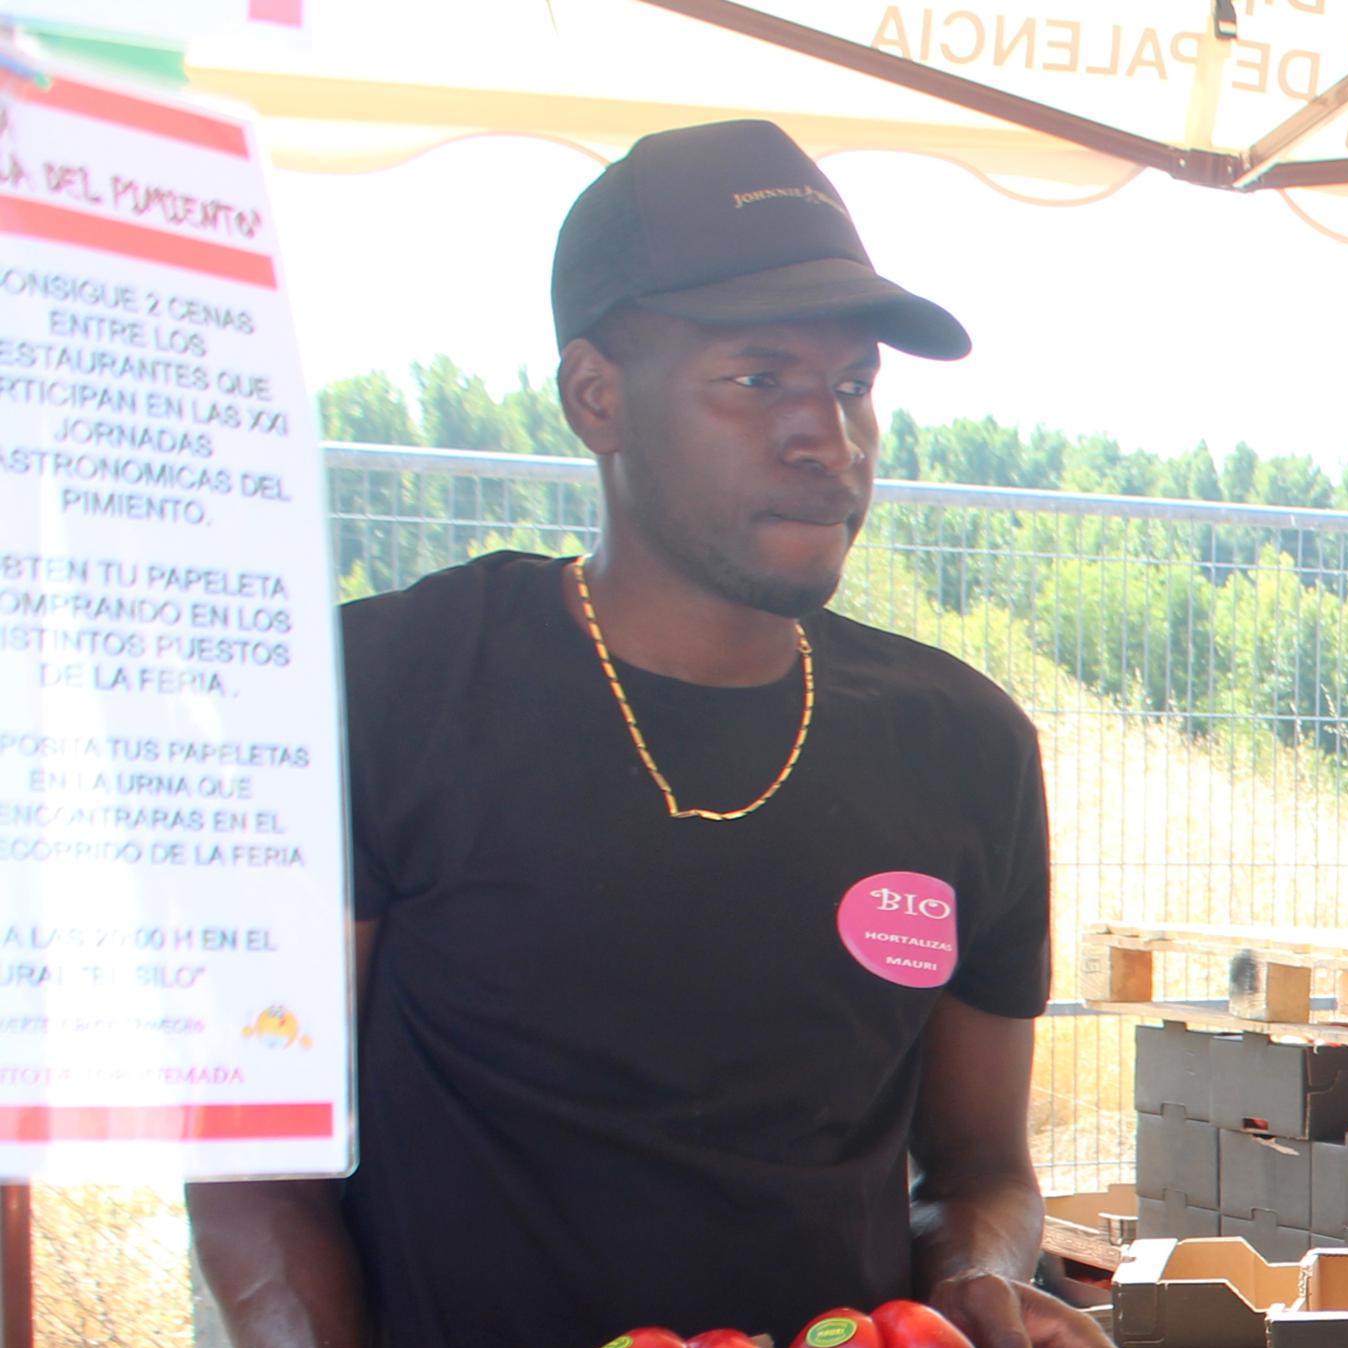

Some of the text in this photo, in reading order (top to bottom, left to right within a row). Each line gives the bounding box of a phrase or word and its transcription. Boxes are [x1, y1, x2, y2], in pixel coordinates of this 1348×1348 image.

[0, 267, 257, 336] ONSIGUE 2 CENAS
[48, 309, 208, 358] ENTRE LOS
[217, 370, 273, 402] QUE
[146, 392, 184, 420] EN
[193, 399, 242, 431] LAS
[53, 417, 215, 459] JORNADAS
[0, 446, 293, 504] STRONOMICAS DEL
[60, 486, 213, 528] PIMIENTO.
[96, 558, 138, 588] TU
[146, 563, 288, 601] PAPELETA
[189, 602, 230, 629] EN
[237, 604, 293, 634] LOS
[156, 634, 292, 669] PUESTOS
[93, 664, 131, 693] LA
[106, 734, 161, 763] TUS
[168, 740, 312, 769] PAPELETAS
[116, 770, 192, 797] URNA
[199, 775, 253, 800] QUE
[212, 808, 249, 833] EN
[255, 810, 286, 835] EL
[150, 842, 186, 867] DE
[192, 844, 225, 867] LA
[231, 844, 306, 870] FERIA
[869, 888, 952, 920] BIO
[200, 926, 239, 952] EN
[244, 926, 280, 953] EL
[864, 931, 953, 952] HORTALIZAS
[885, 956, 938, 971] MAURI
